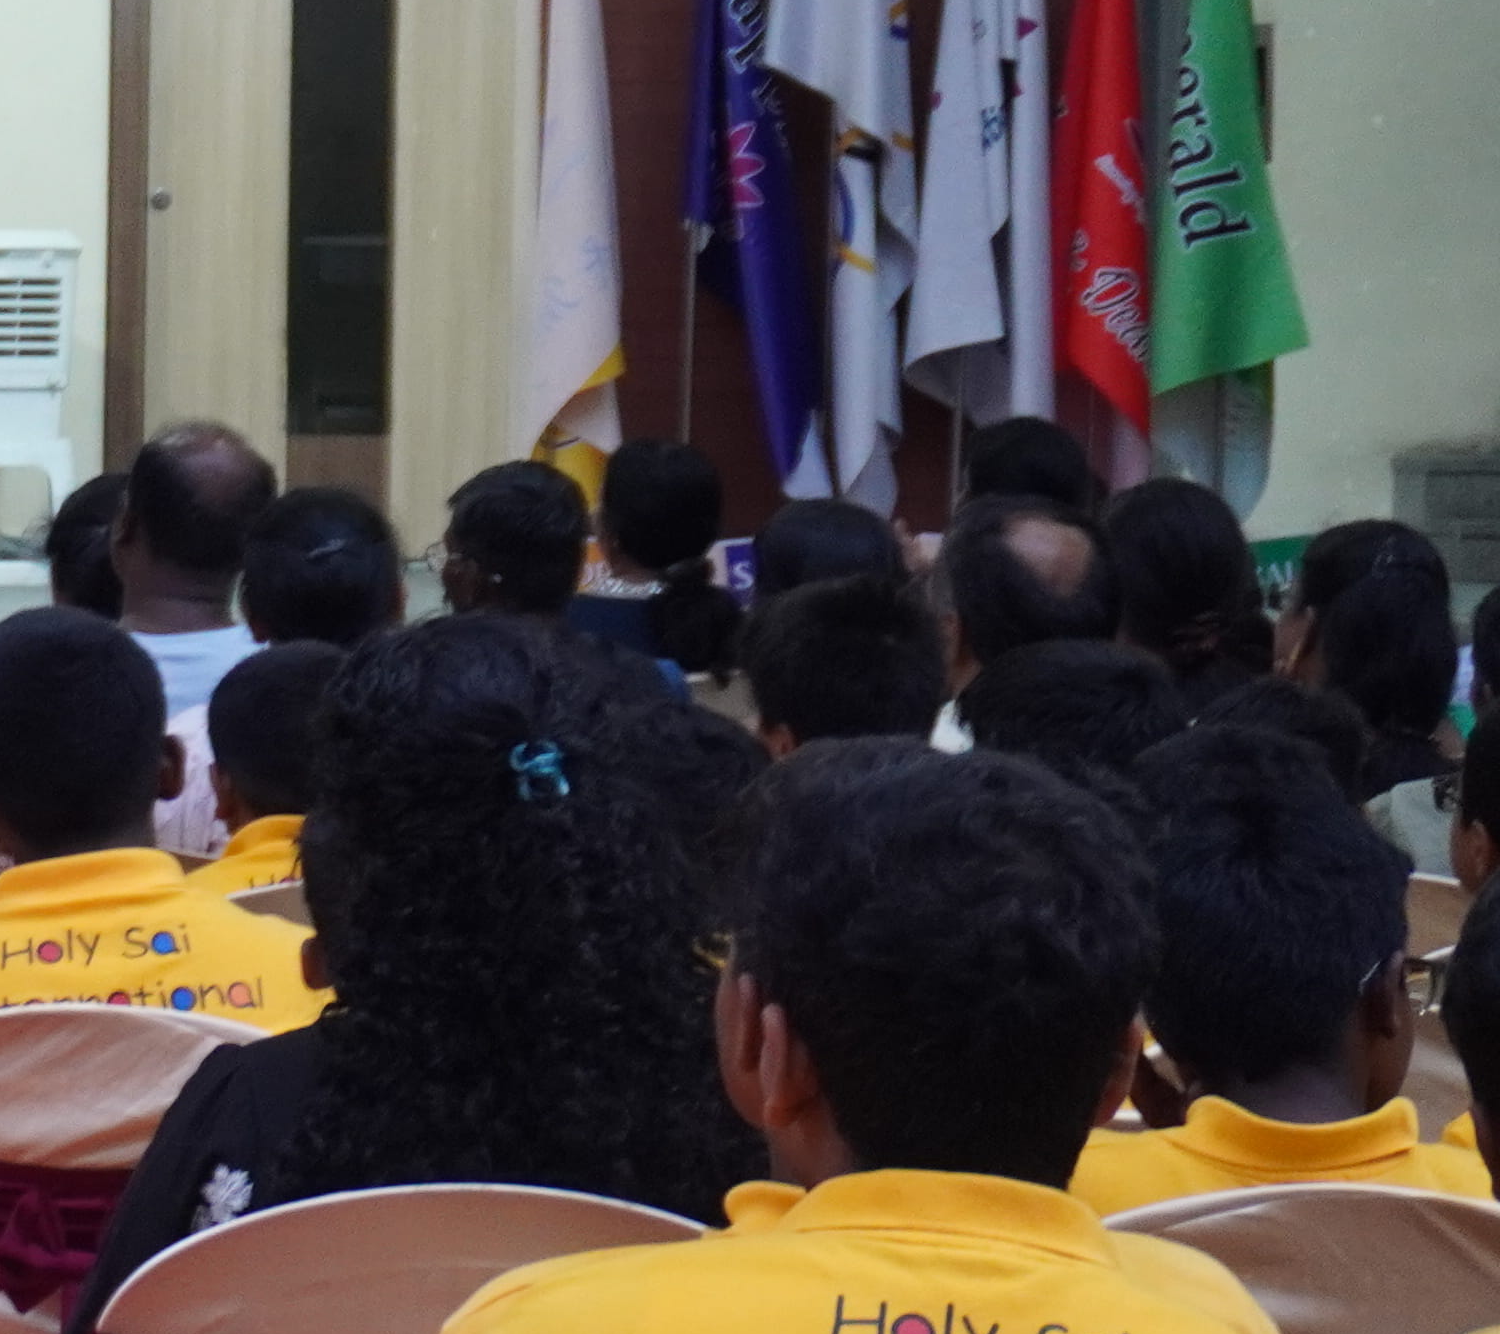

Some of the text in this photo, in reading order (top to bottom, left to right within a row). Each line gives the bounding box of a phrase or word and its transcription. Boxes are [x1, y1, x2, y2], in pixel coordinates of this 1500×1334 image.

[1170, 29, 1253, 247] erald
[0, 923, 192, 970] Holy Sai
